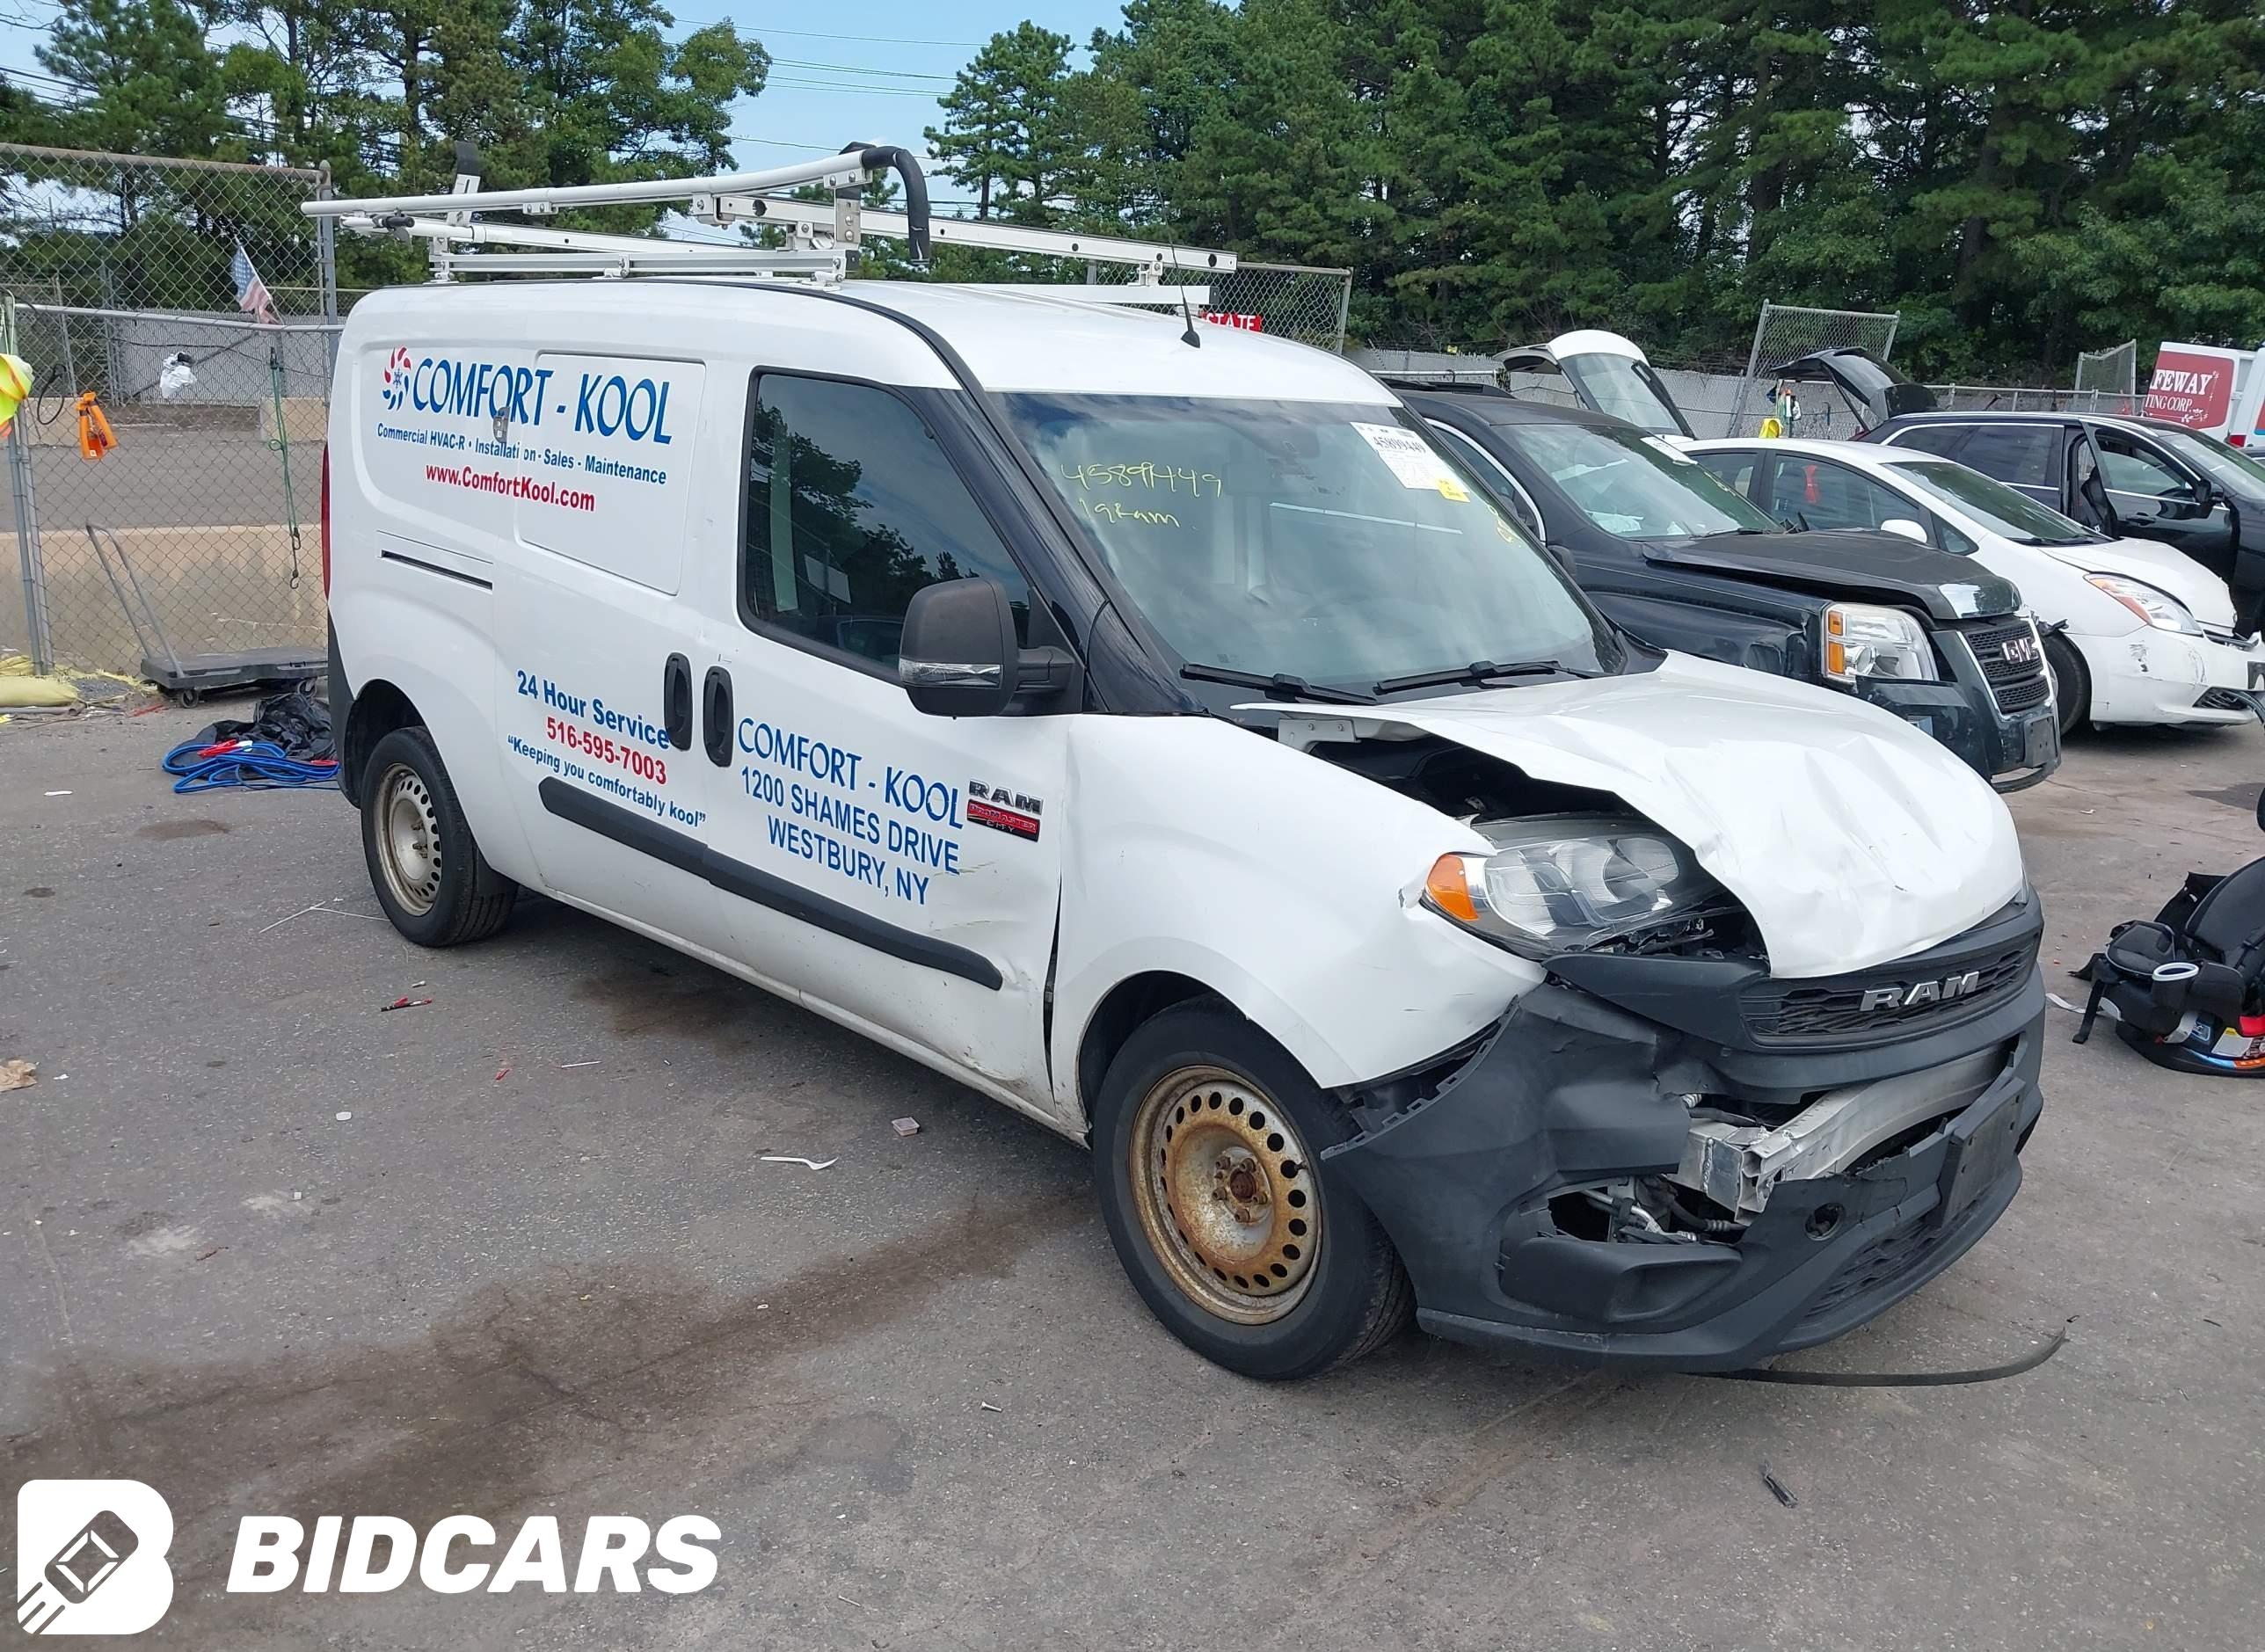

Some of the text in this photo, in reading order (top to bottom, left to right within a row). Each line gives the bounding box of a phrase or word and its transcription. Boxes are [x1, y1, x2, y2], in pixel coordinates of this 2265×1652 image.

[413, 358, 553, 426] COMFORT
[574, 373, 672, 445] KOOL
[2167, 397, 2192, 412] CORP.
[377, 423, 428, 445] Commercial
[430, 431, 466, 450] HVAC-R
[543, 448, 574, 469] Sales
[585, 455, 666, 484] Maintenance
[426, 465, 595, 512] www.ComfortKool.com
[2002, 637, 2038, 664] GMC
[517, 670, 669, 749] 24 Hour Service
[547, 717, 666, 784] 516-595-7003
[739, 718, 862, 790] COMFORT
[885, 767, 963, 829] KOOL
[564, 761, 584, 781] you
[588, 771, 666, 816] comfortably
[969, 779, 1044, 815] RAM
[742, 766, 960, 875] 1200 SHAMES DRIVE
[987, 819, 1014, 832] CITY
[768, 815, 929, 905] WESTBURY, NY
[1860, 971, 1979, 1011] RAM
